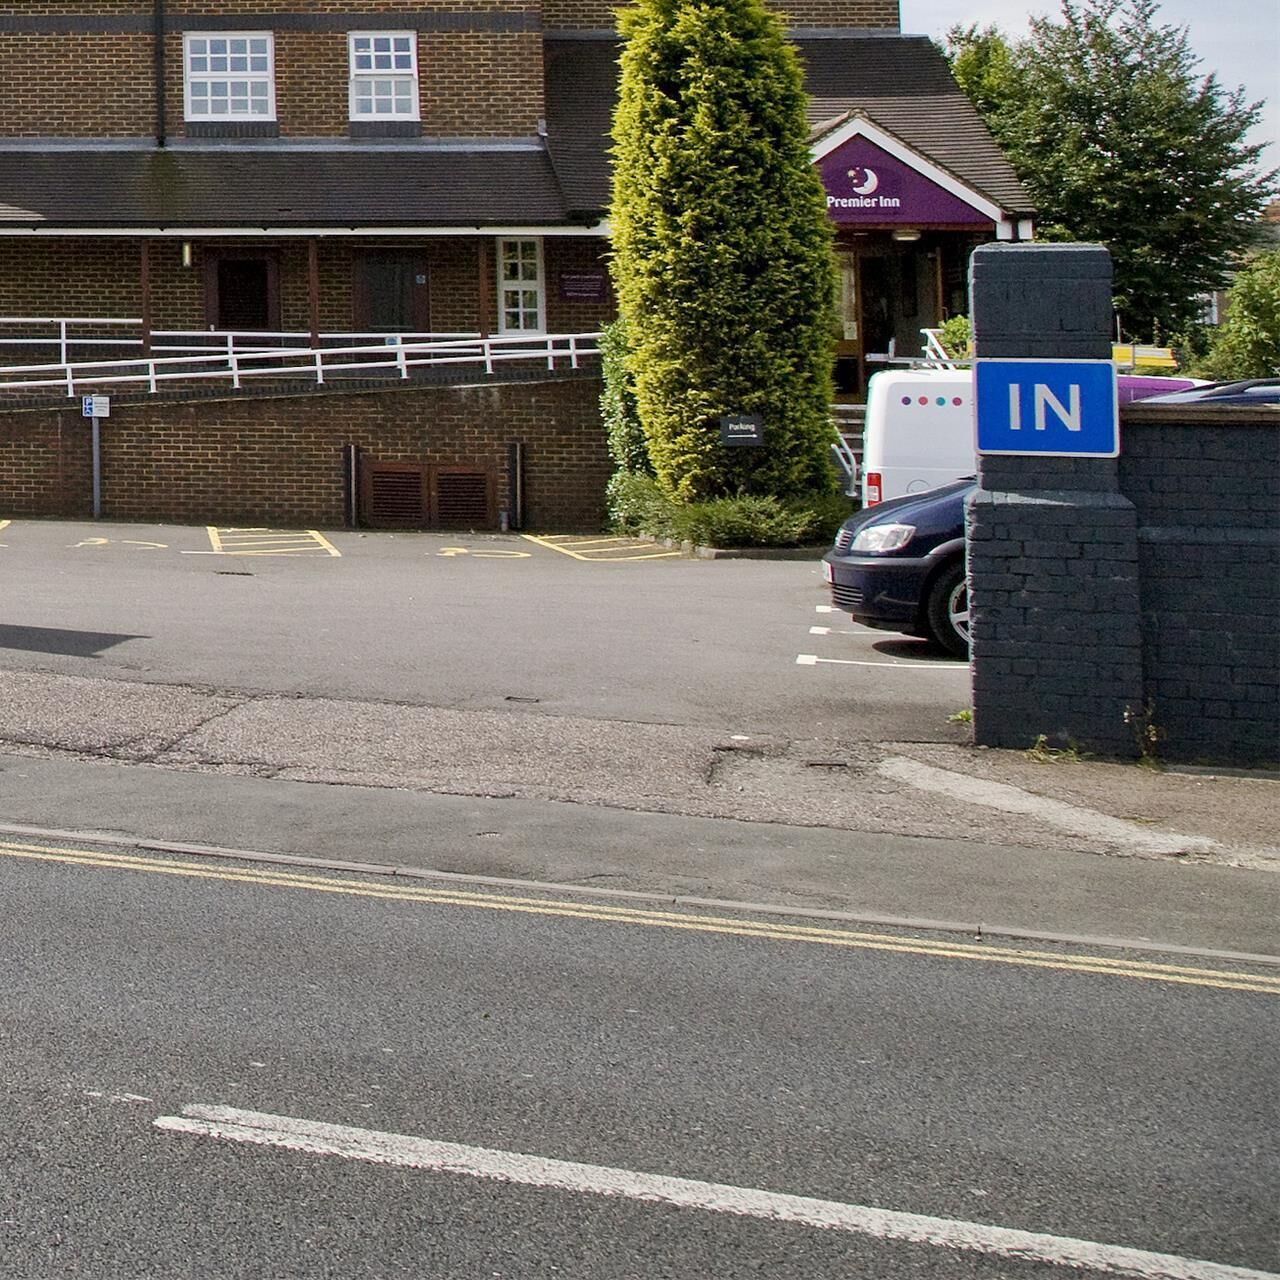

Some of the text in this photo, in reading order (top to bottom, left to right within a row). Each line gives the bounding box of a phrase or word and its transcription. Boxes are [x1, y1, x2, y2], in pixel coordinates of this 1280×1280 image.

[826, 195, 900, 208] Premier Inn
[1008, 383, 1081, 431] IN
